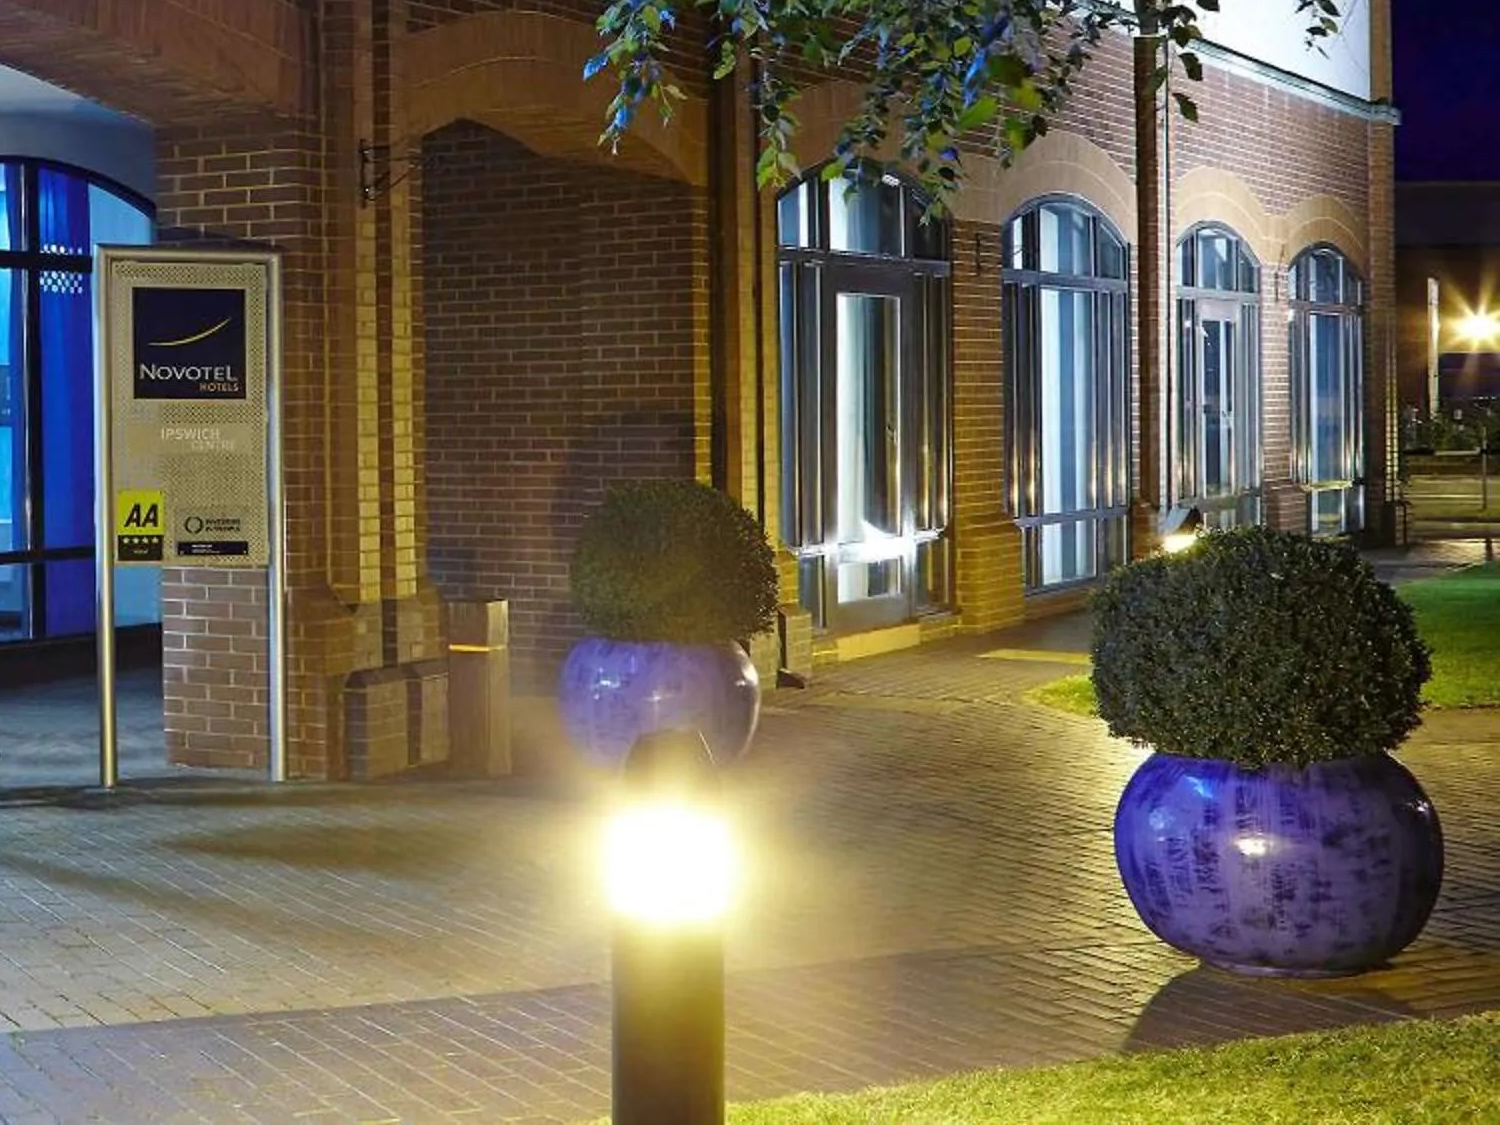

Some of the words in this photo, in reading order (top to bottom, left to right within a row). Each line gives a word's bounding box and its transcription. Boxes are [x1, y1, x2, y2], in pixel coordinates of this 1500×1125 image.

[139, 363, 238, 382] NOVOTEL
[199, 382, 240, 392] HOTELS
[161, 427, 221, 441] IPSWICH
[123, 503, 159, 528] AA
